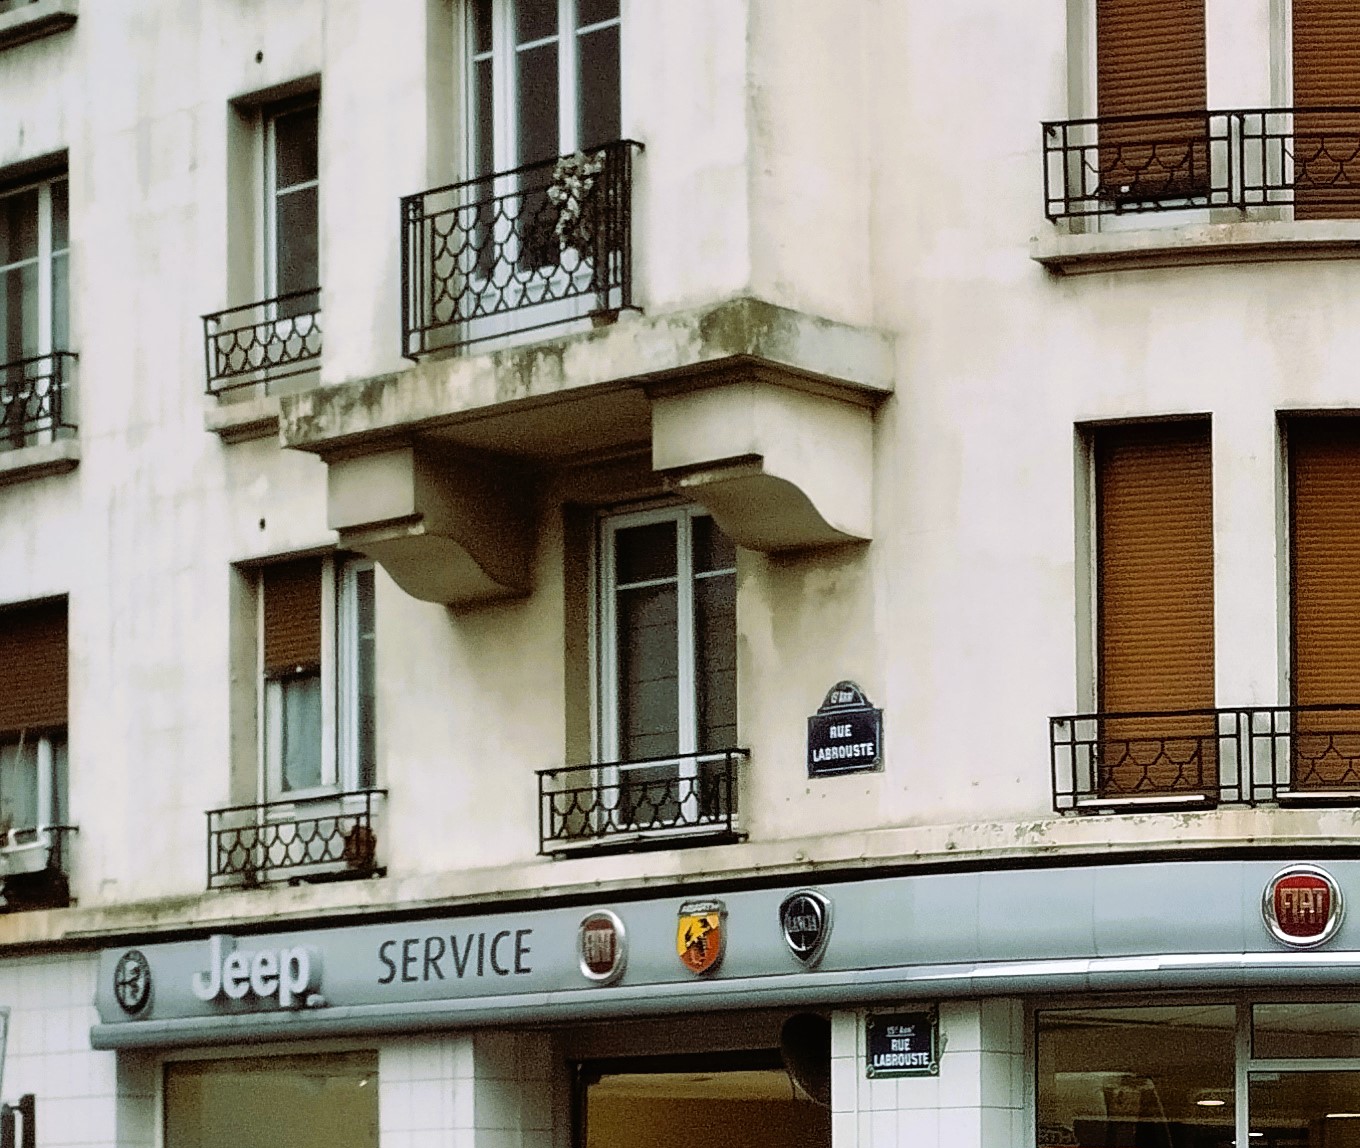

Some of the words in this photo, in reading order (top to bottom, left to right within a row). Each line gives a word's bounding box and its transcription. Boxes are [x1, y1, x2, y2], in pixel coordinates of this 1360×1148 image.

[829, 724, 853, 739] RUE
[813, 742, 875, 763] LABROUSTE
[1280, 887, 1327, 924] FIAT
[378, 929, 534, 984] SERVICE
[192, 934, 311, 1008] Jeep
[891, 1038, 911, 1051] RUE
[873, 1052, 930, 1067] LABROUSTE
